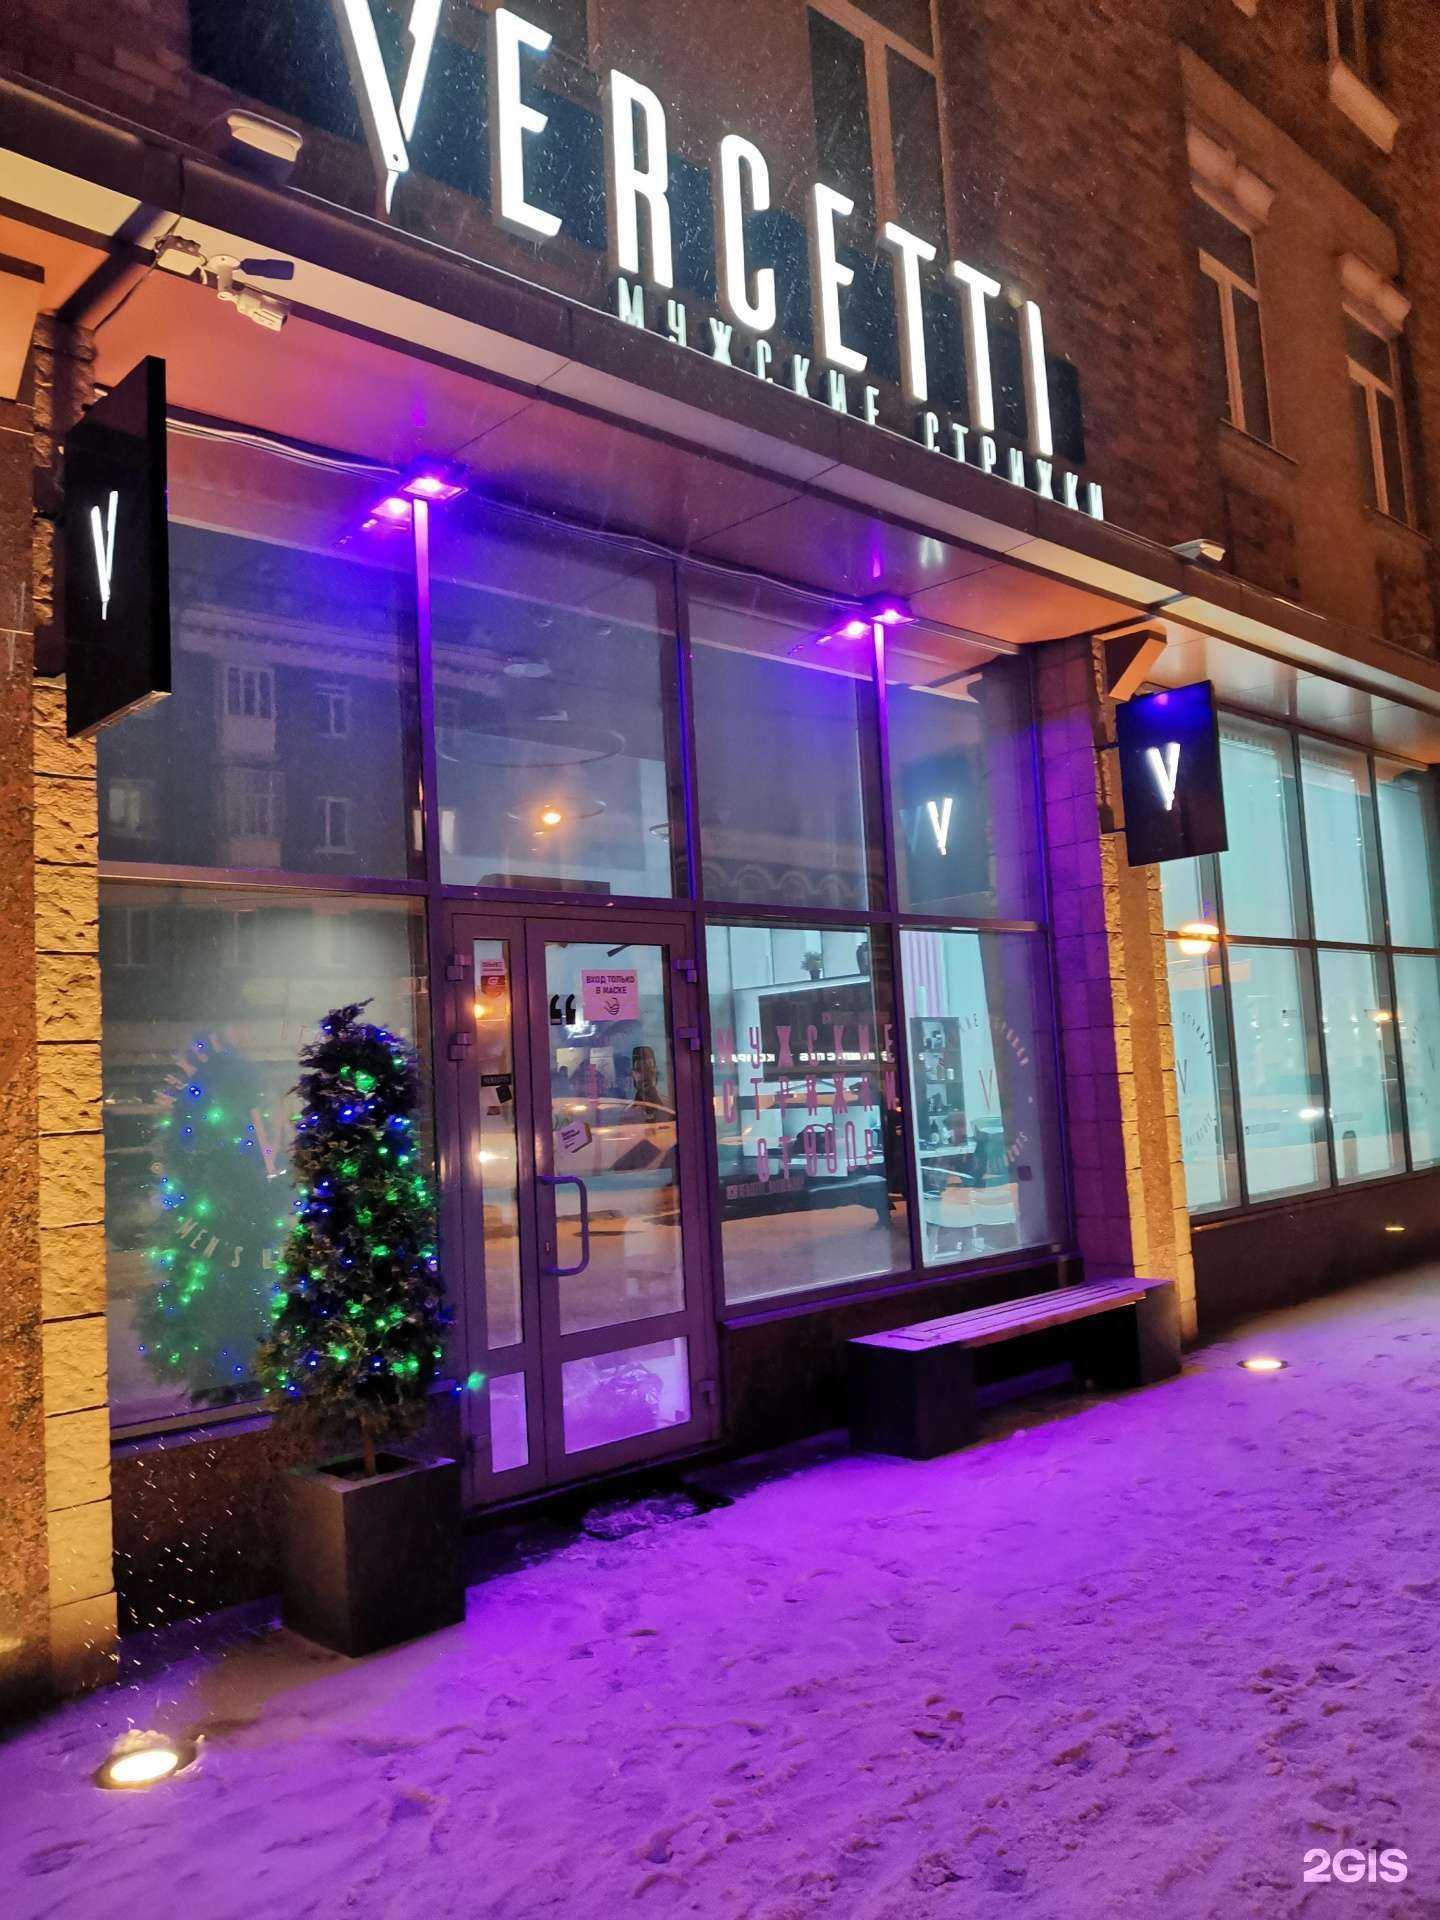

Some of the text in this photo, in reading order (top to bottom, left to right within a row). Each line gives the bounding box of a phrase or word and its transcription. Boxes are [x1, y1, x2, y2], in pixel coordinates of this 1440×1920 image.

[342, 0, 1053, 456] VERCETTI
[617, 276, 1104, 521] МУЖСКИЕ СТРИЖКИ
[91, 490, 119, 620] V
[1148, 742, 1181, 811] V
[716, 1024, 896, 1072] МУЖСКИЕ
